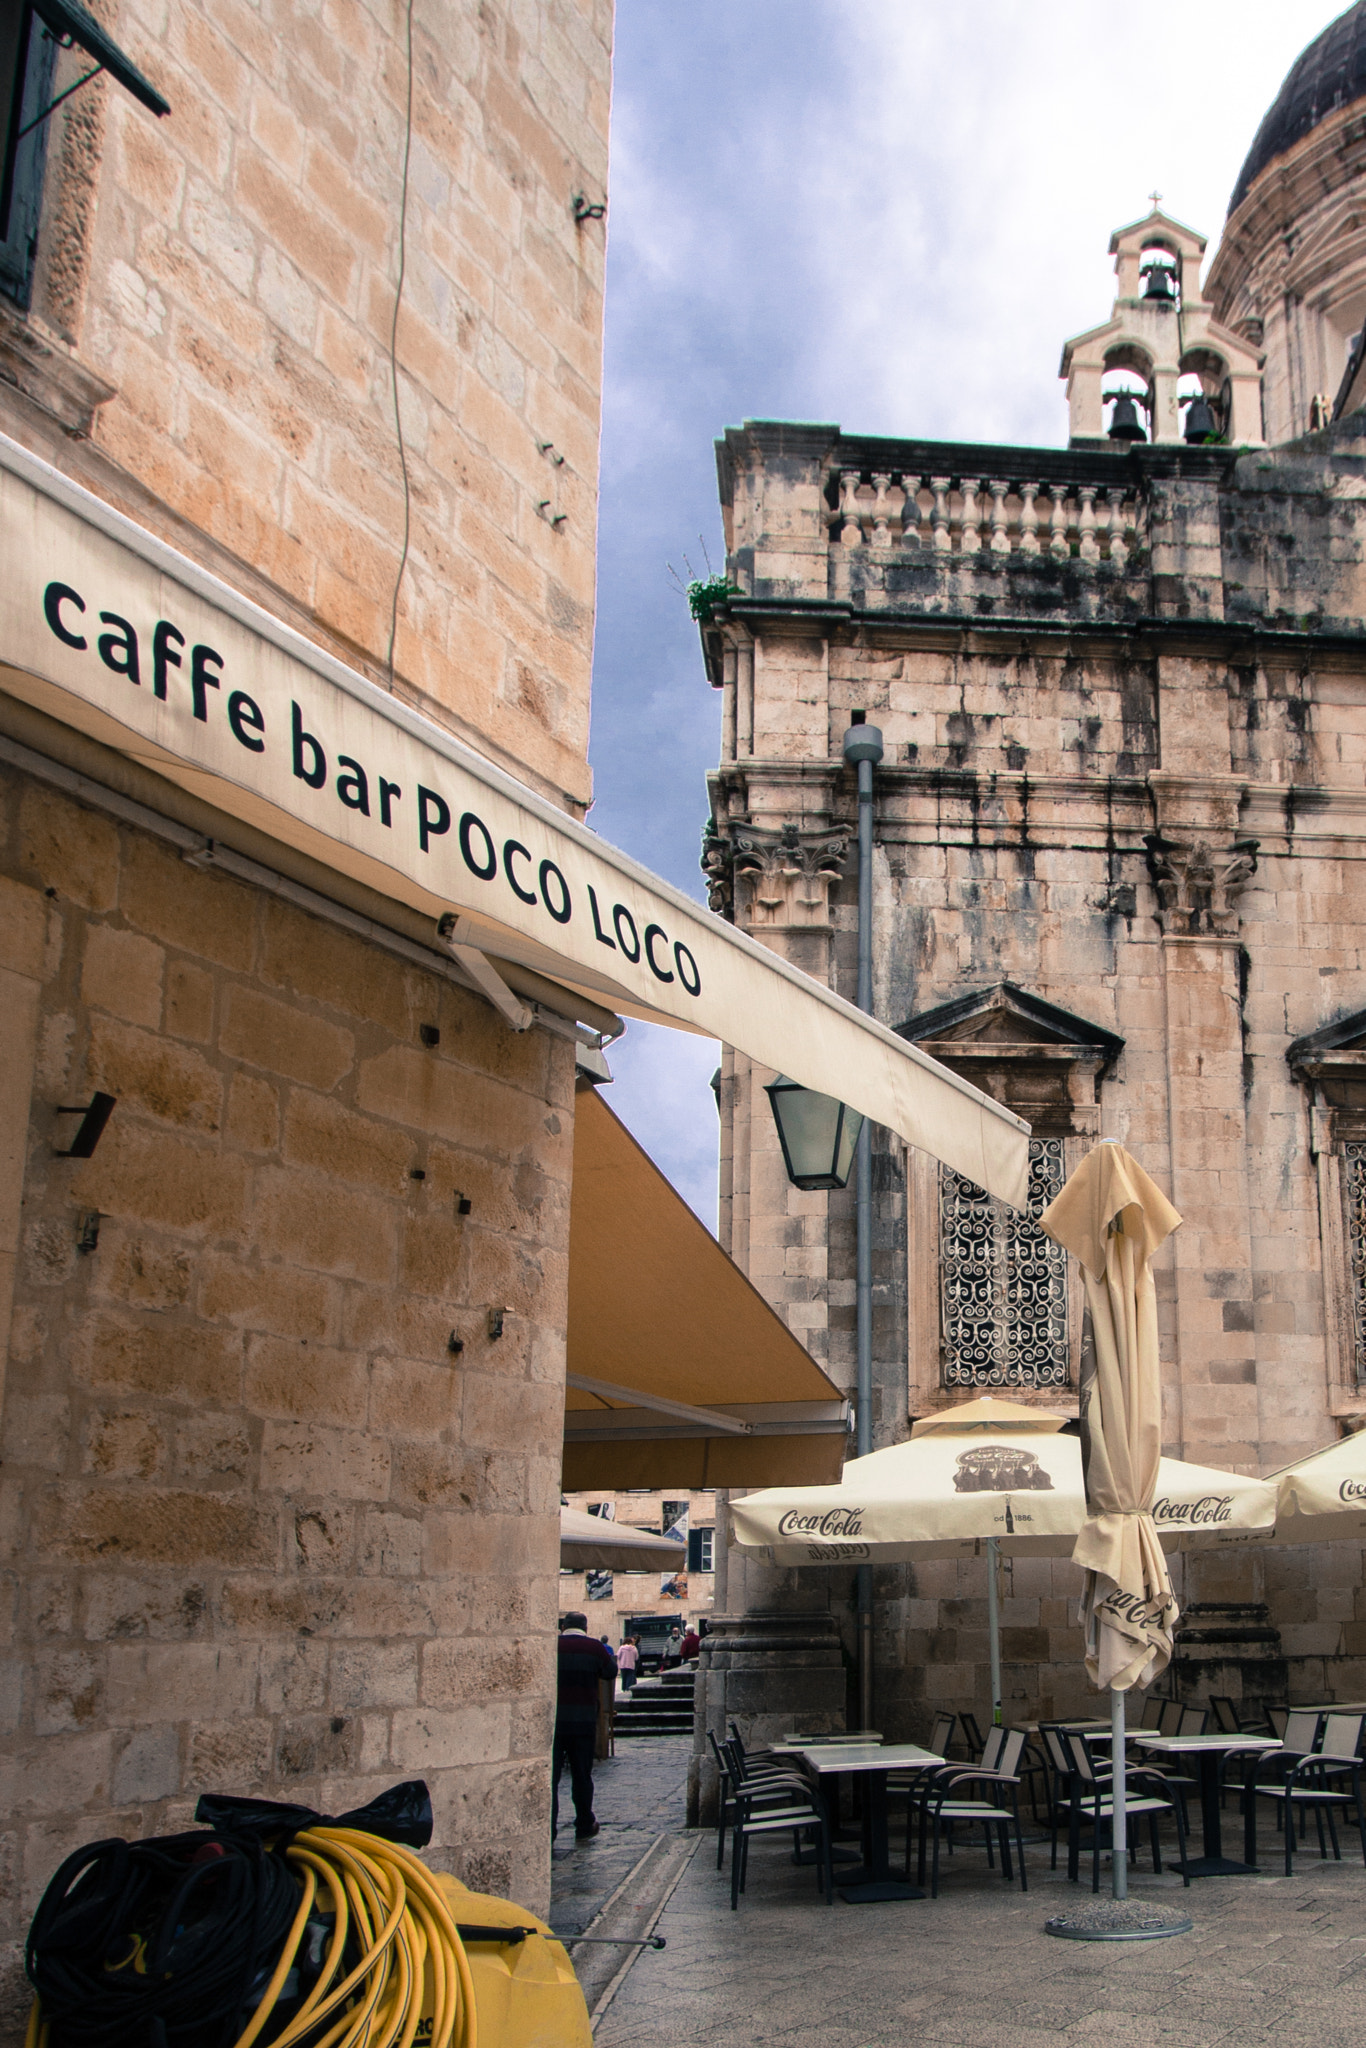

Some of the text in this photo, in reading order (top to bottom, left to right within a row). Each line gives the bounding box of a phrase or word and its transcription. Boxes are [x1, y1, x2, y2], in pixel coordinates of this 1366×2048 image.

[43, 581, 702, 997] caffe bar POCO LOCO
[1339, 1479, 1366, 1502] Coc
[778, 1507, 867, 1536] Coca-Cola
